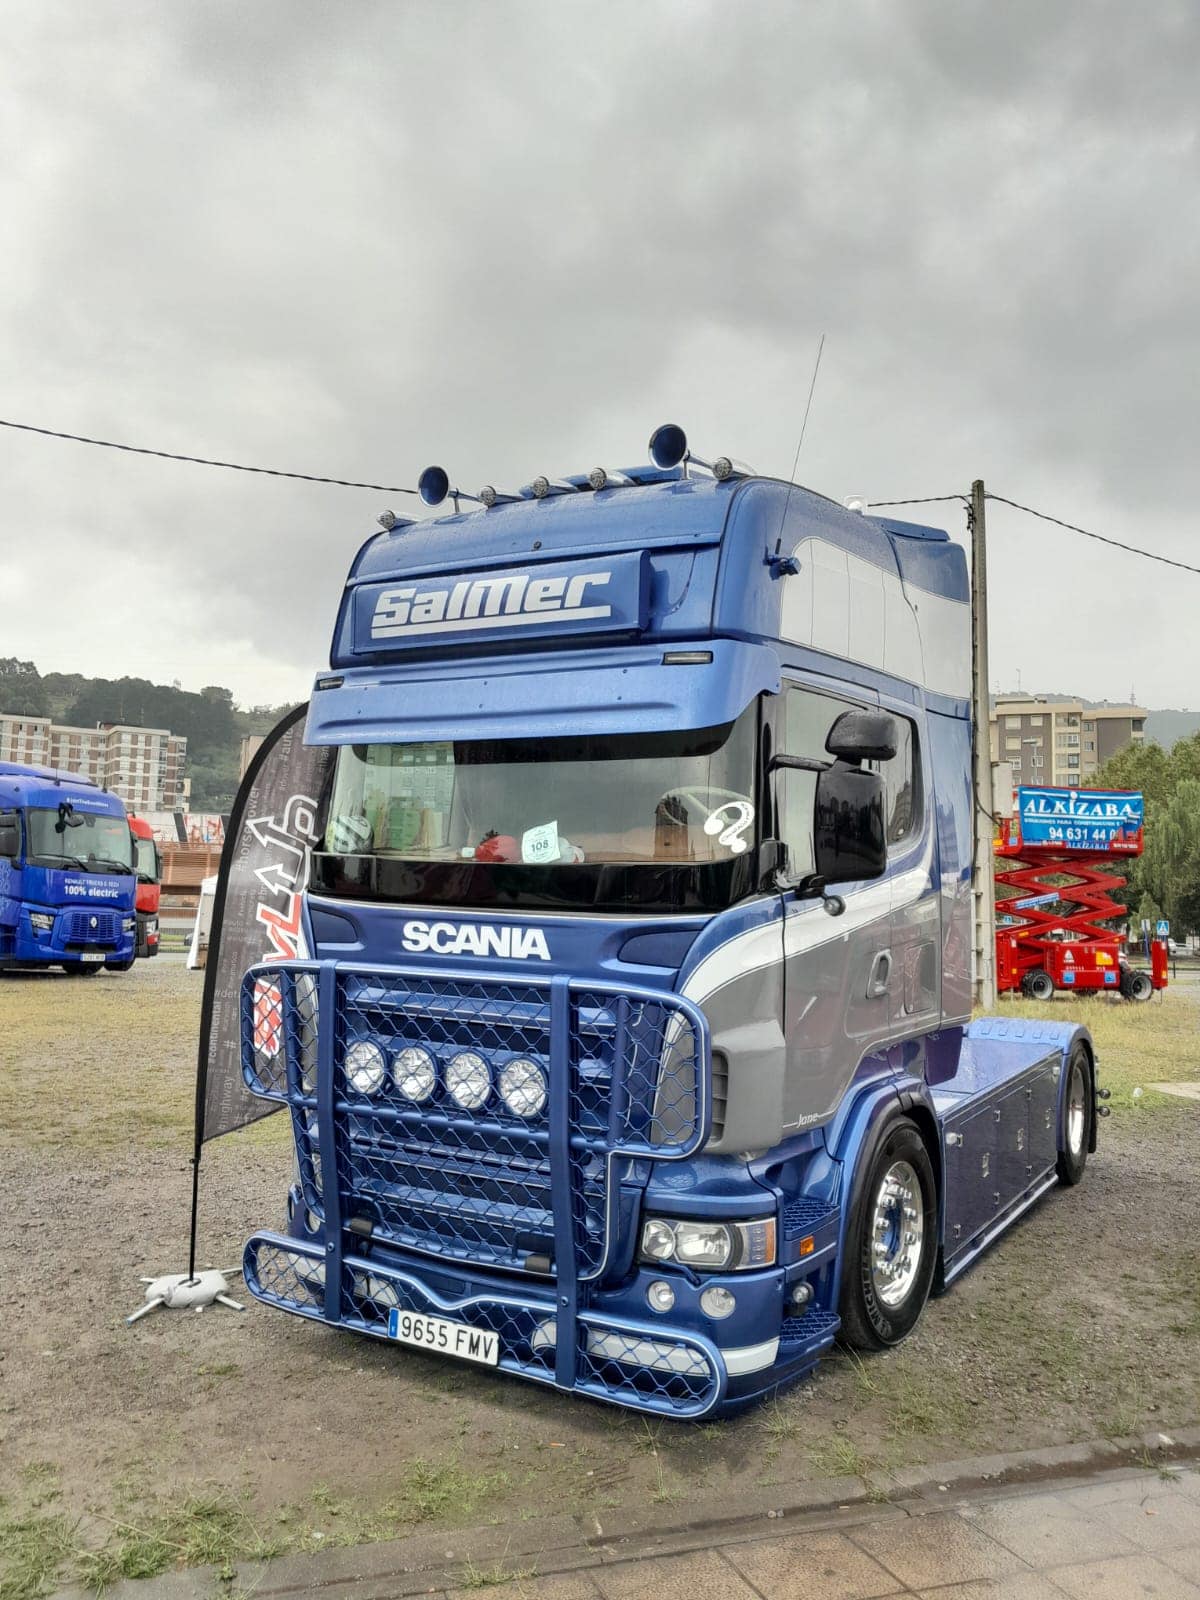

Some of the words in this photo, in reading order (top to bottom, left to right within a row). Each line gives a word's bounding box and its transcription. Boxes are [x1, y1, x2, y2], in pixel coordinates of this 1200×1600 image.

[234, 787, 260, 873] #horseower
[1049, 826, 1063, 839] 94
[1066, 828, 1088, 840] 631
[1092, 829, 1106, 840] 44
[531, 839, 549, 852] 108
[64, 886, 87, 897] 100%
[88, 888, 119, 899] electric
[401, 921, 551, 960] SCANIA
[402, 1316, 448, 1348] 9655
[456, 1329, 494, 1359] FMV
